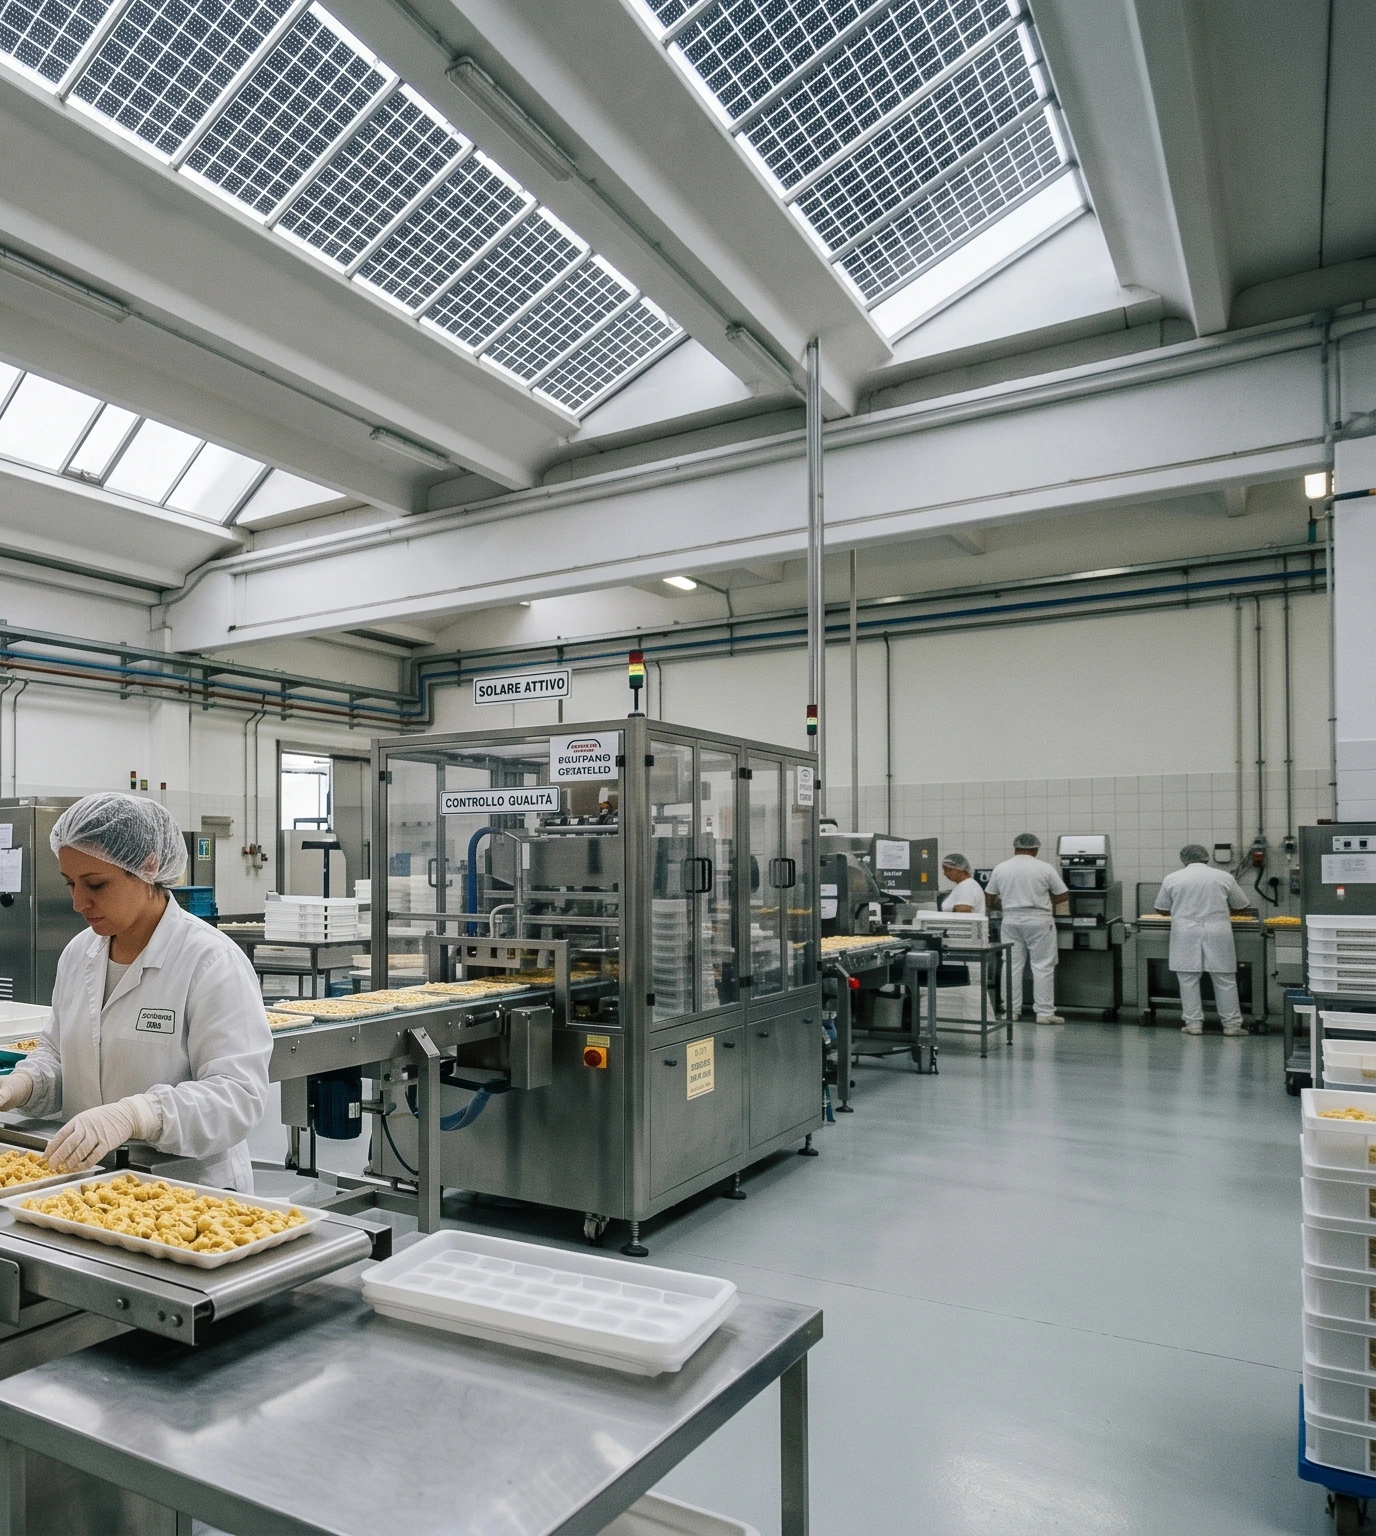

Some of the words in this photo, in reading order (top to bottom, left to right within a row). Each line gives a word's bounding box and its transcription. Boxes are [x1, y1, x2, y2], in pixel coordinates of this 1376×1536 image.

[478, 682, 521, 697] SOLARE
[524, 677, 565, 693] ATTIVO
[445, 796, 505, 808] CONTROLLO
